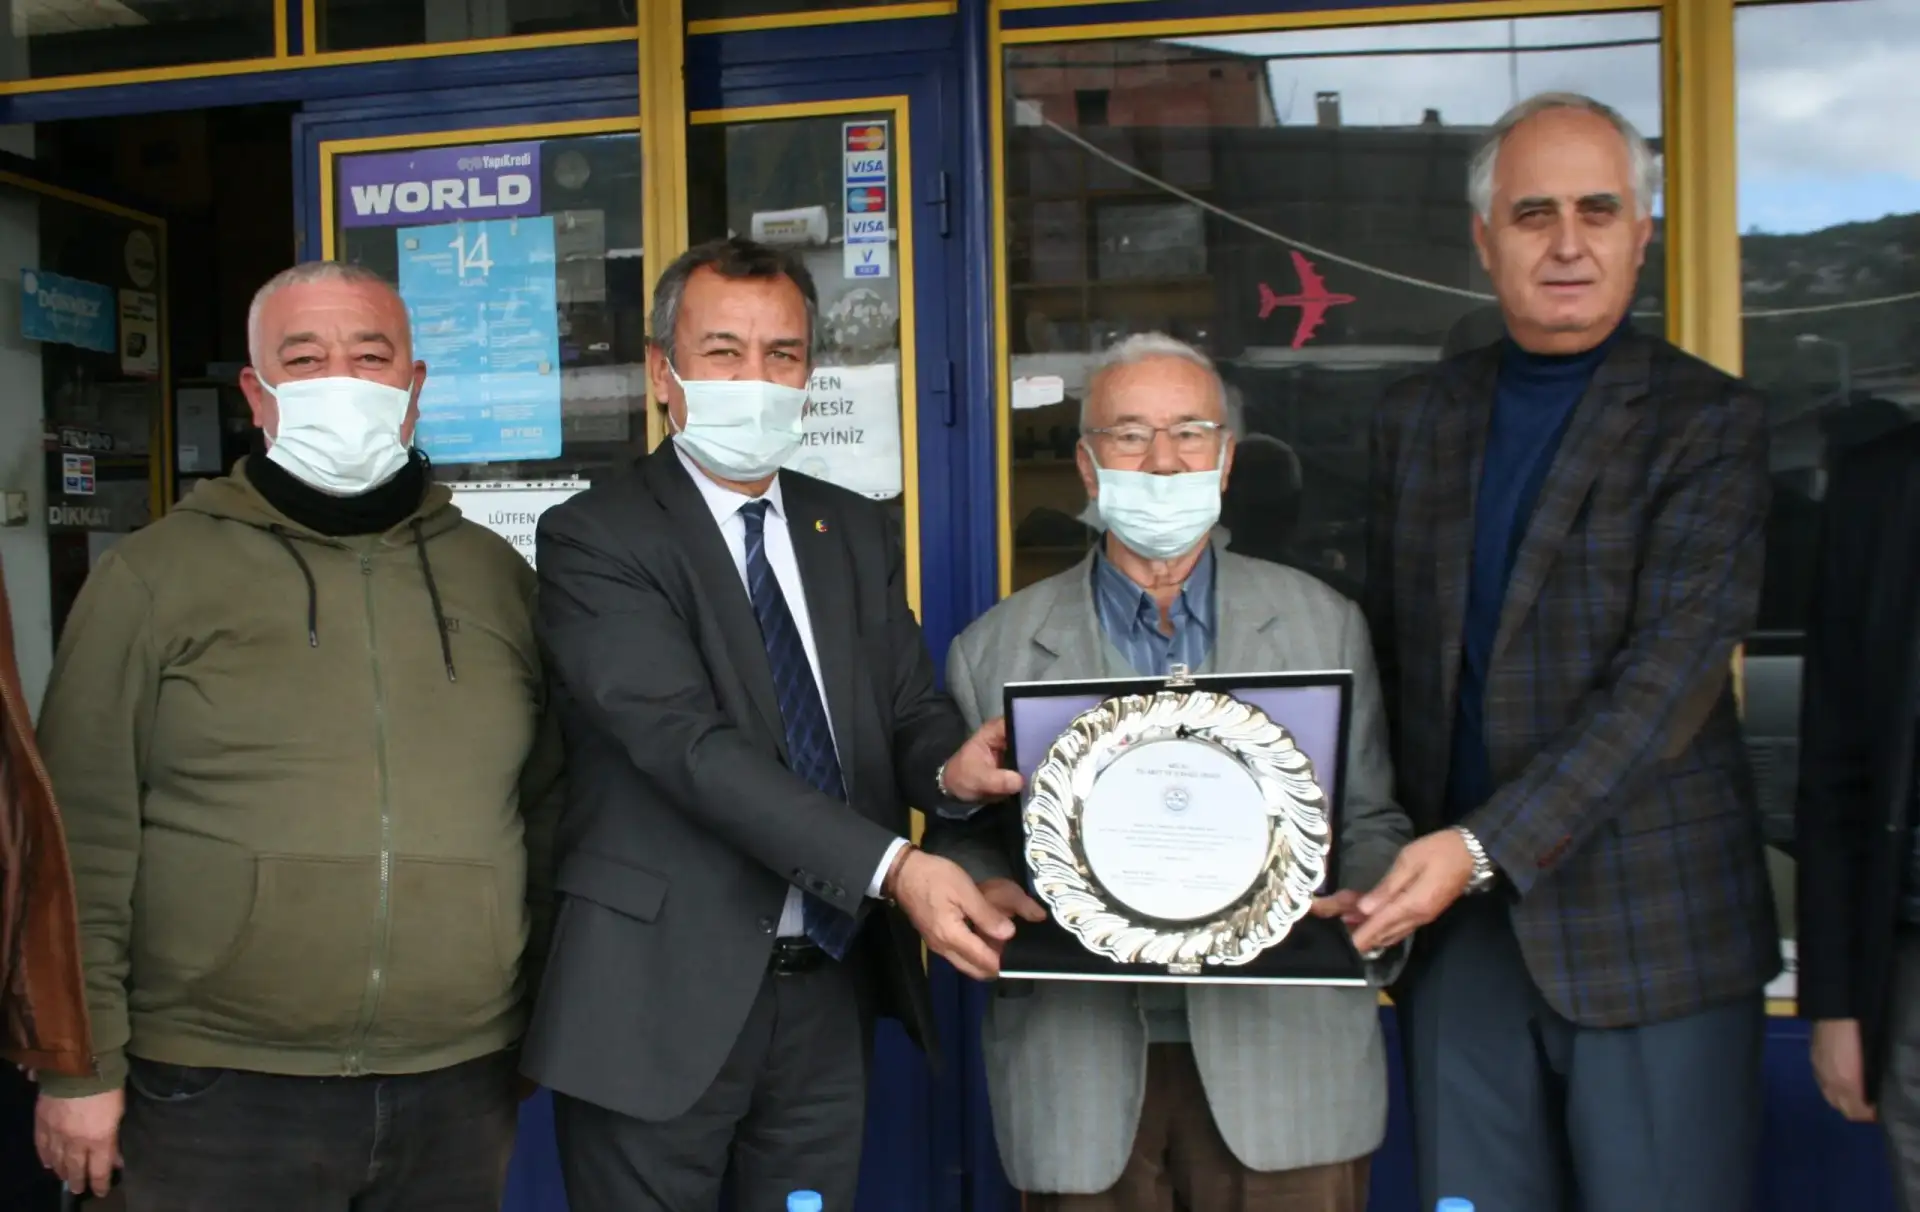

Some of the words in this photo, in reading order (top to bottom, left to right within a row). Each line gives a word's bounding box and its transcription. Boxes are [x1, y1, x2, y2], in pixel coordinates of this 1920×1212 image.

[482, 152, 531, 170] YapıKredi
[852, 160, 884, 173] VISA
[351, 174, 532, 216] WORLD
[853, 220, 885, 233] VISA
[448, 231, 495, 278] 14
[48, 501, 111, 526] DİKKAT
[488, 510, 537, 525] LÜTFEN
[504, 534, 537, 547] MES
